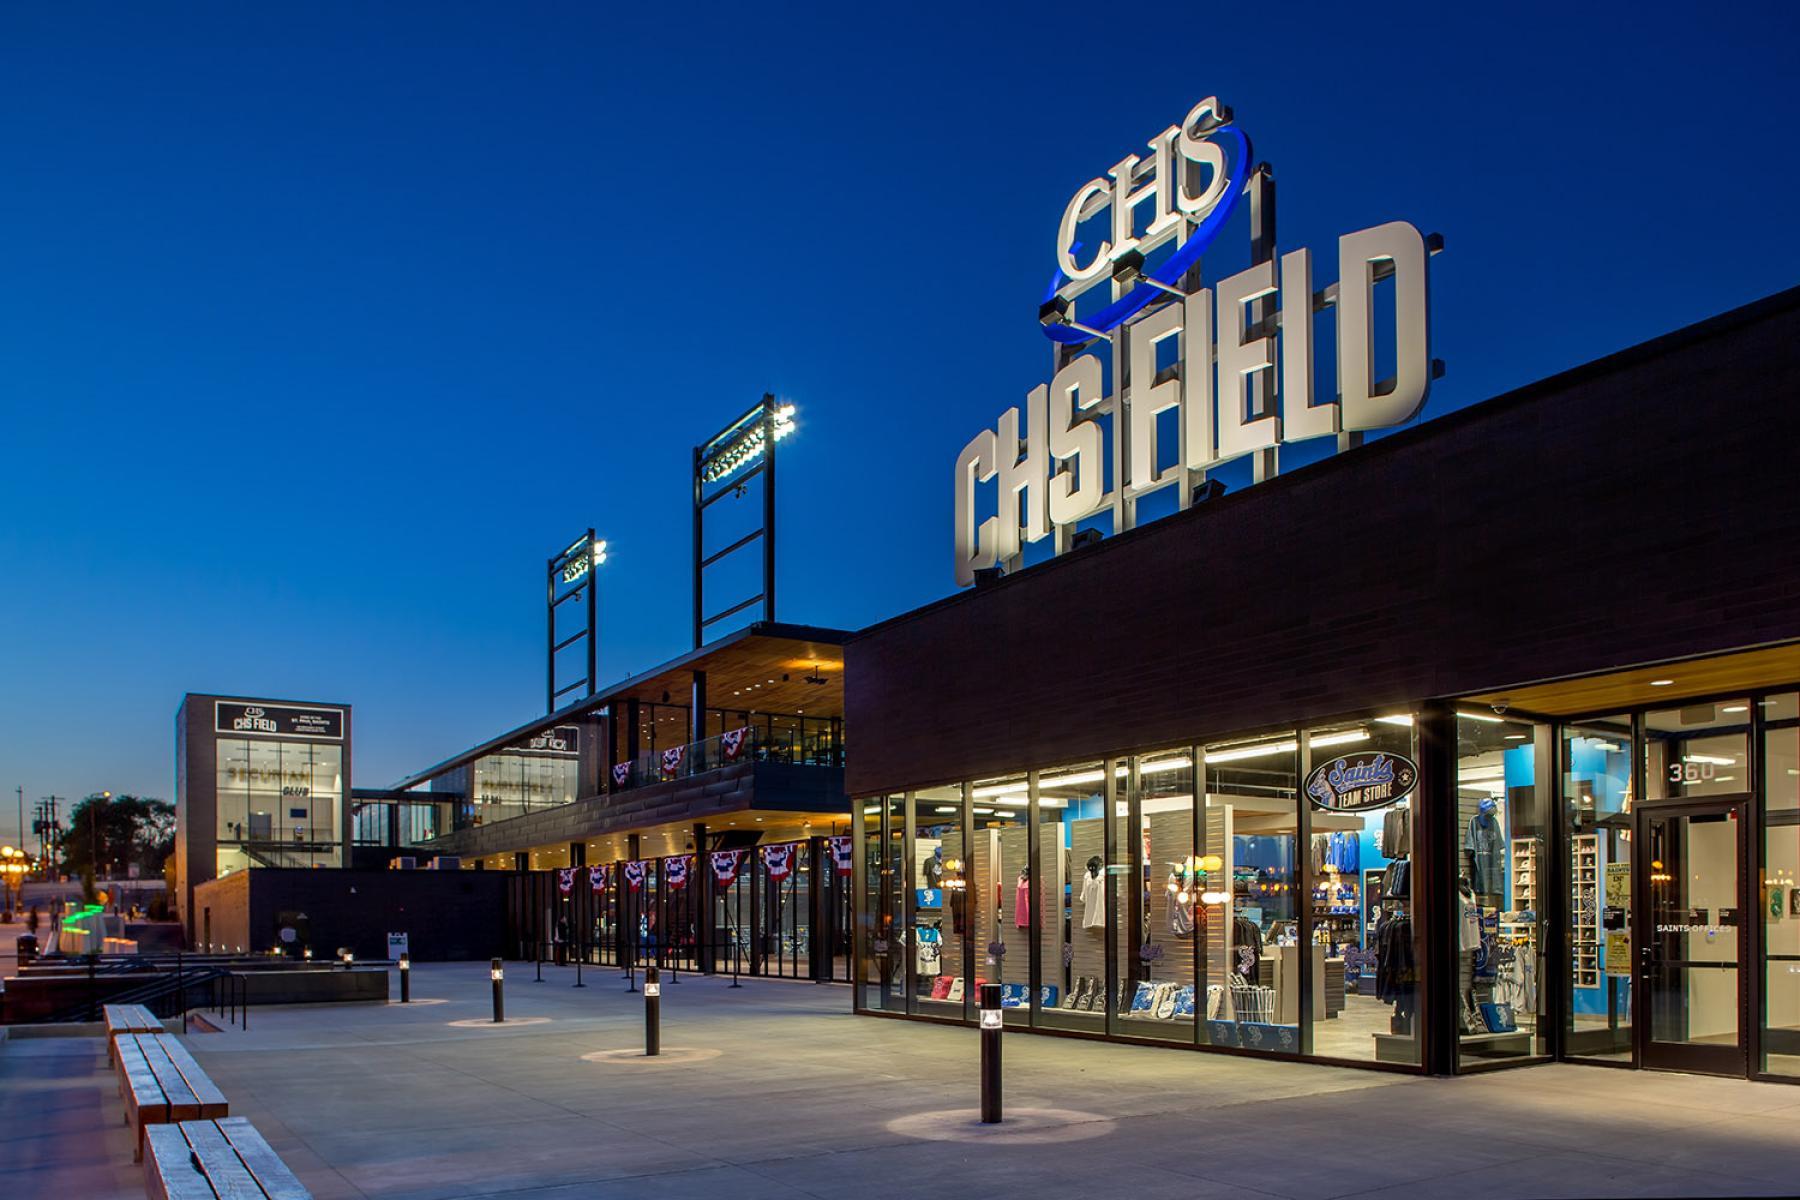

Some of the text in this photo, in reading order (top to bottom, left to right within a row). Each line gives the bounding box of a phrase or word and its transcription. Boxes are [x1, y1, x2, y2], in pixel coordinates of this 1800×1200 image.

[1056, 96, 1231, 281] CHS
[955, 220, 1432, 587] CHS FIELD
[233, 717, 253, 730] CHS
[253, 718, 277, 732] FIELD
[1328, 754, 1395, 790] Saints
[1669, 763, 1714, 782] 360
[1338, 782, 1393, 809] TEAM STORE
[1656, 924, 1733, 933] SAINTS OFFICES
